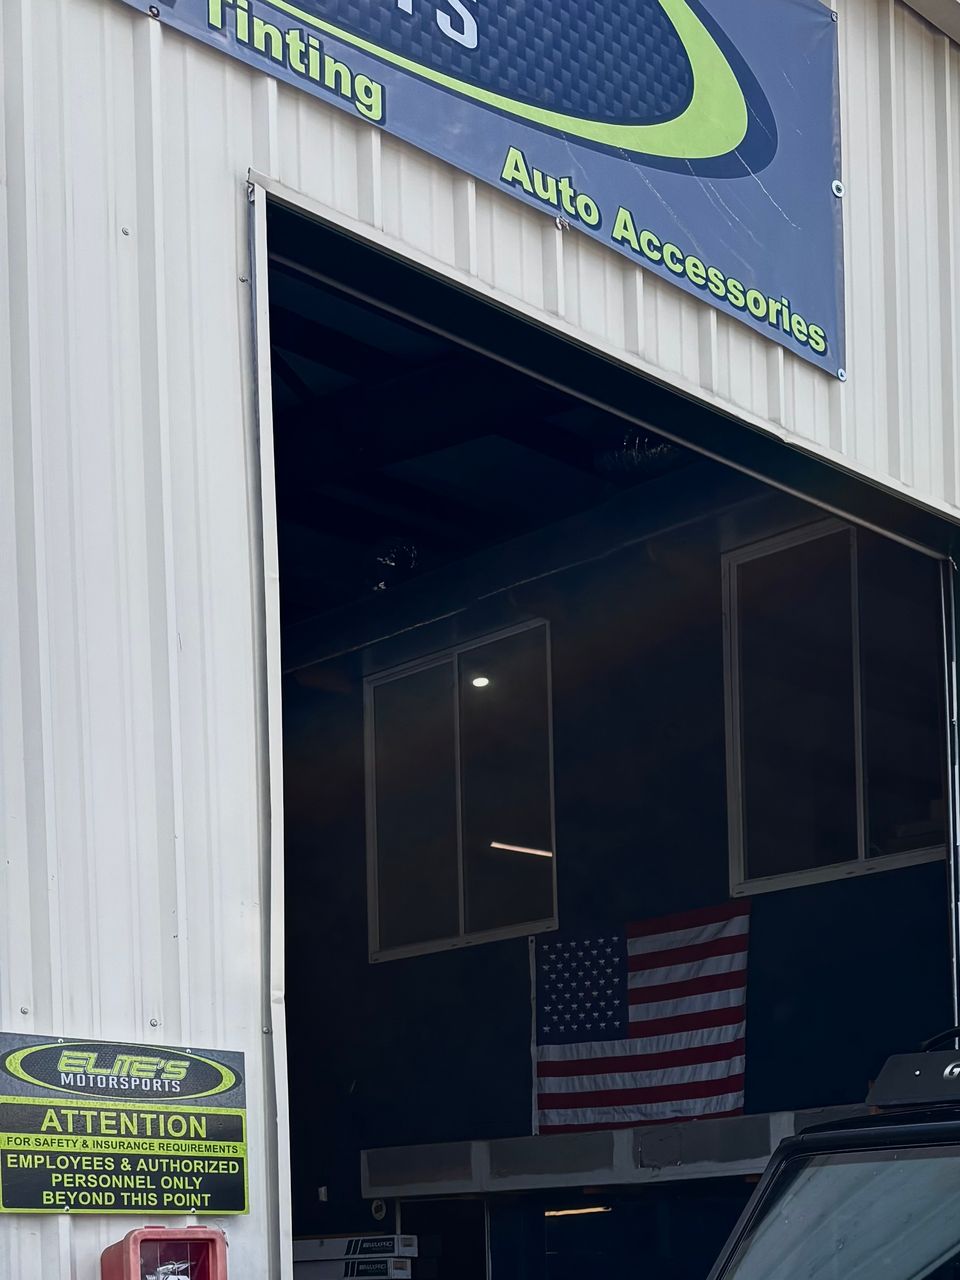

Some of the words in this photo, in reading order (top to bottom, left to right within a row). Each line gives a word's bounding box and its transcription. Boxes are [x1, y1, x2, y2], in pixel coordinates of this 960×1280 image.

[501, 145, 600, 227] Auto
[612, 206, 828, 353] Accessories
[61, 1073, 181, 1092] MOTORSPORTS
[40, 1108, 208, 1138] ATTENTION
[7, 1136, 31, 1147] FOR
[35, 1138, 79, 1149] SAFETY
[82, 1140, 89, 1148] &
[93, 1140, 155, 1151] INSURANCE
[158, 1143, 238, 1154] REQUIREMENTS
[7, 1154, 115, 1171] EMPLOYEES
[121, 1158, 131, 1171] &
[136, 1158, 240, 1174] AUTHORIZED
[51, 1173, 156, 1190] PERSONNEL
[160, 1176, 203, 1190] ONLY
[42, 1191, 115, 1206] BEYOND
[121, 1192, 157, 1206] THIS
[163, 1193, 211, 1207] POINT
